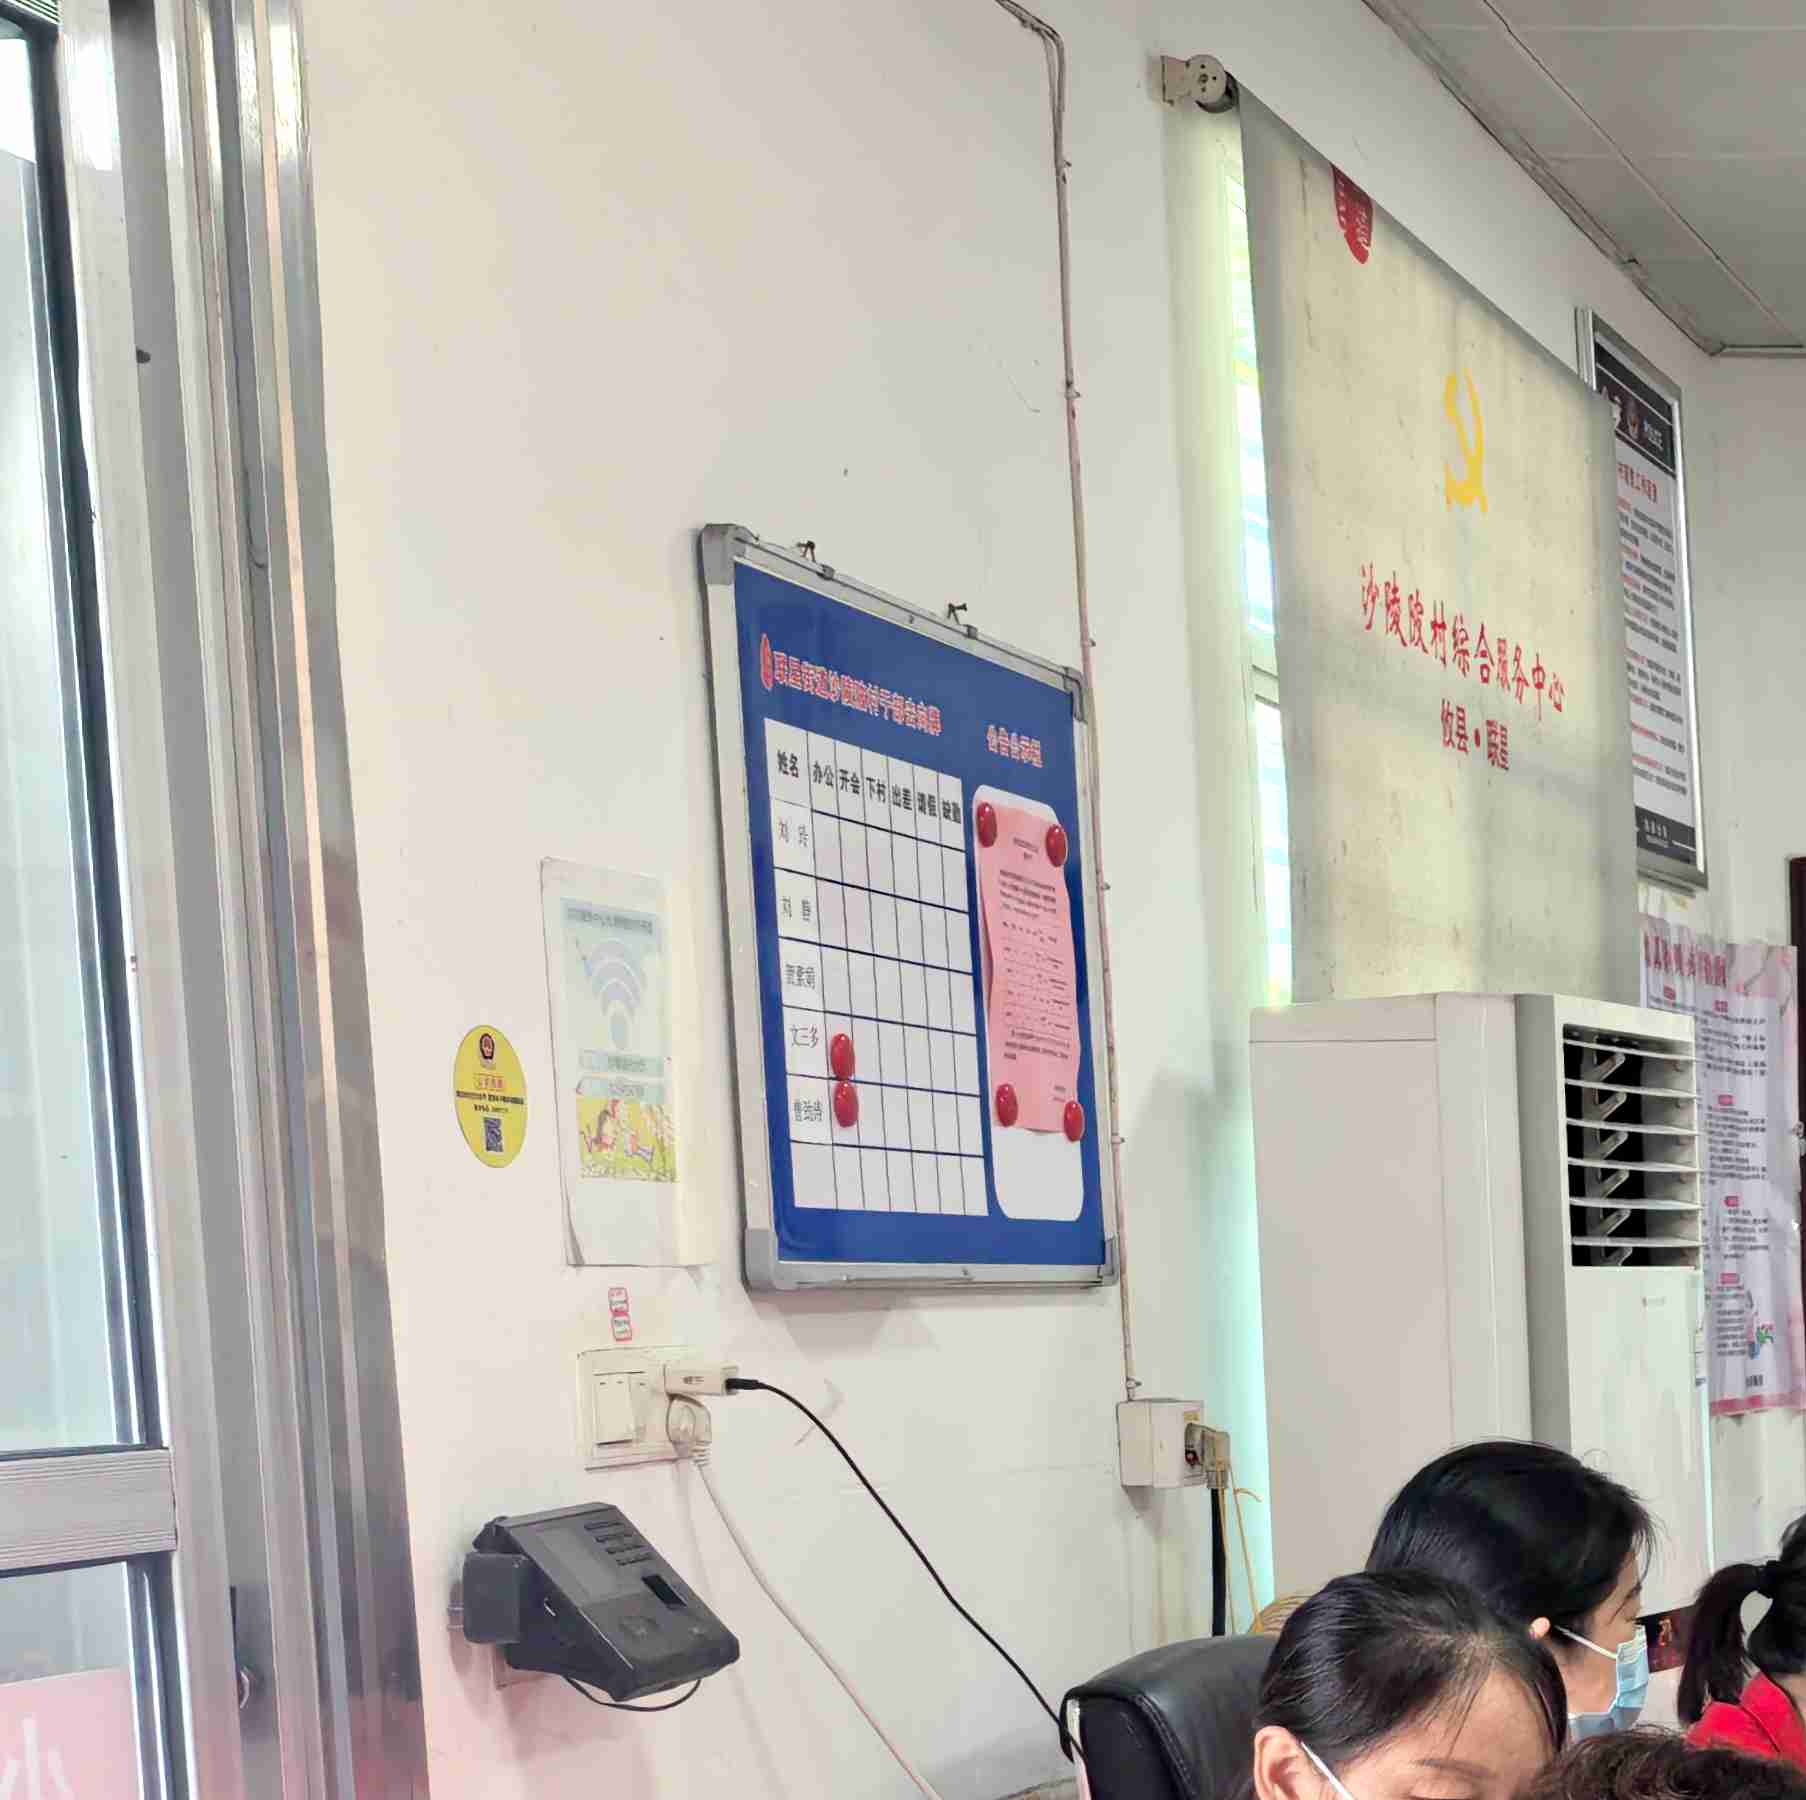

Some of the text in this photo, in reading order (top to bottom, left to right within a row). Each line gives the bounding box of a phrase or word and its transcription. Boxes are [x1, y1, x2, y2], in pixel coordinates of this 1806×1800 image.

[1361, 561, 1564, 720] 沙陵陂村综合服务中心
[777, 749, 799, 778] 姓名
[812, 761, 834, 786] 办公
[839, 769, 861, 795] 开会
[866, 777, 887, 803] 下村
[891, 783, 913, 811] 出差
